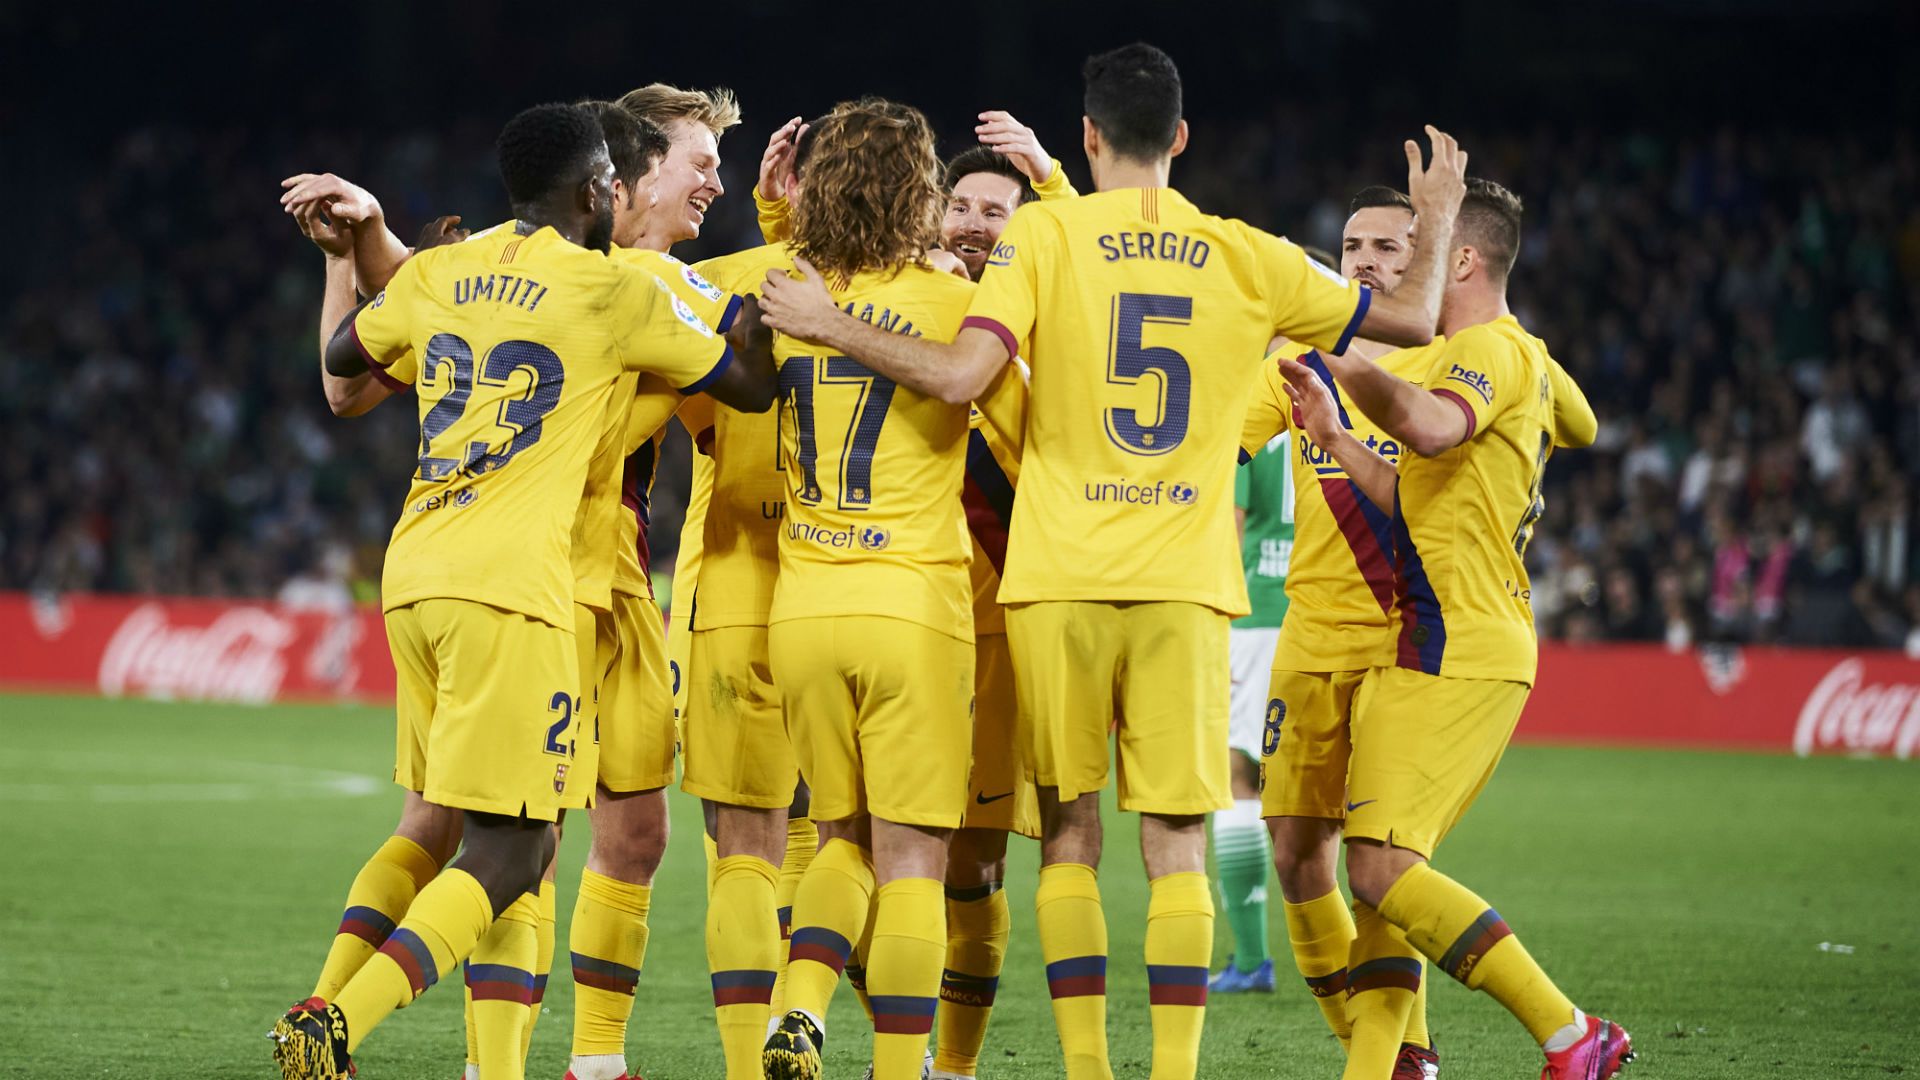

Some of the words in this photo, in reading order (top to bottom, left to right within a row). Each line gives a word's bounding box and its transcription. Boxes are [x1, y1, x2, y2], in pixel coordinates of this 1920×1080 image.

[1098, 231, 1210, 269] SERGIO
[454, 274, 548, 312] UMTITI
[1104, 292, 1193, 457] 5
[413, 333, 565, 483] 23
[777, 355, 897, 511] 17
[1085, 478, 1164, 506] unicef
[787, 521, 856, 550] unicef
[1261, 698, 1287, 757] 8
